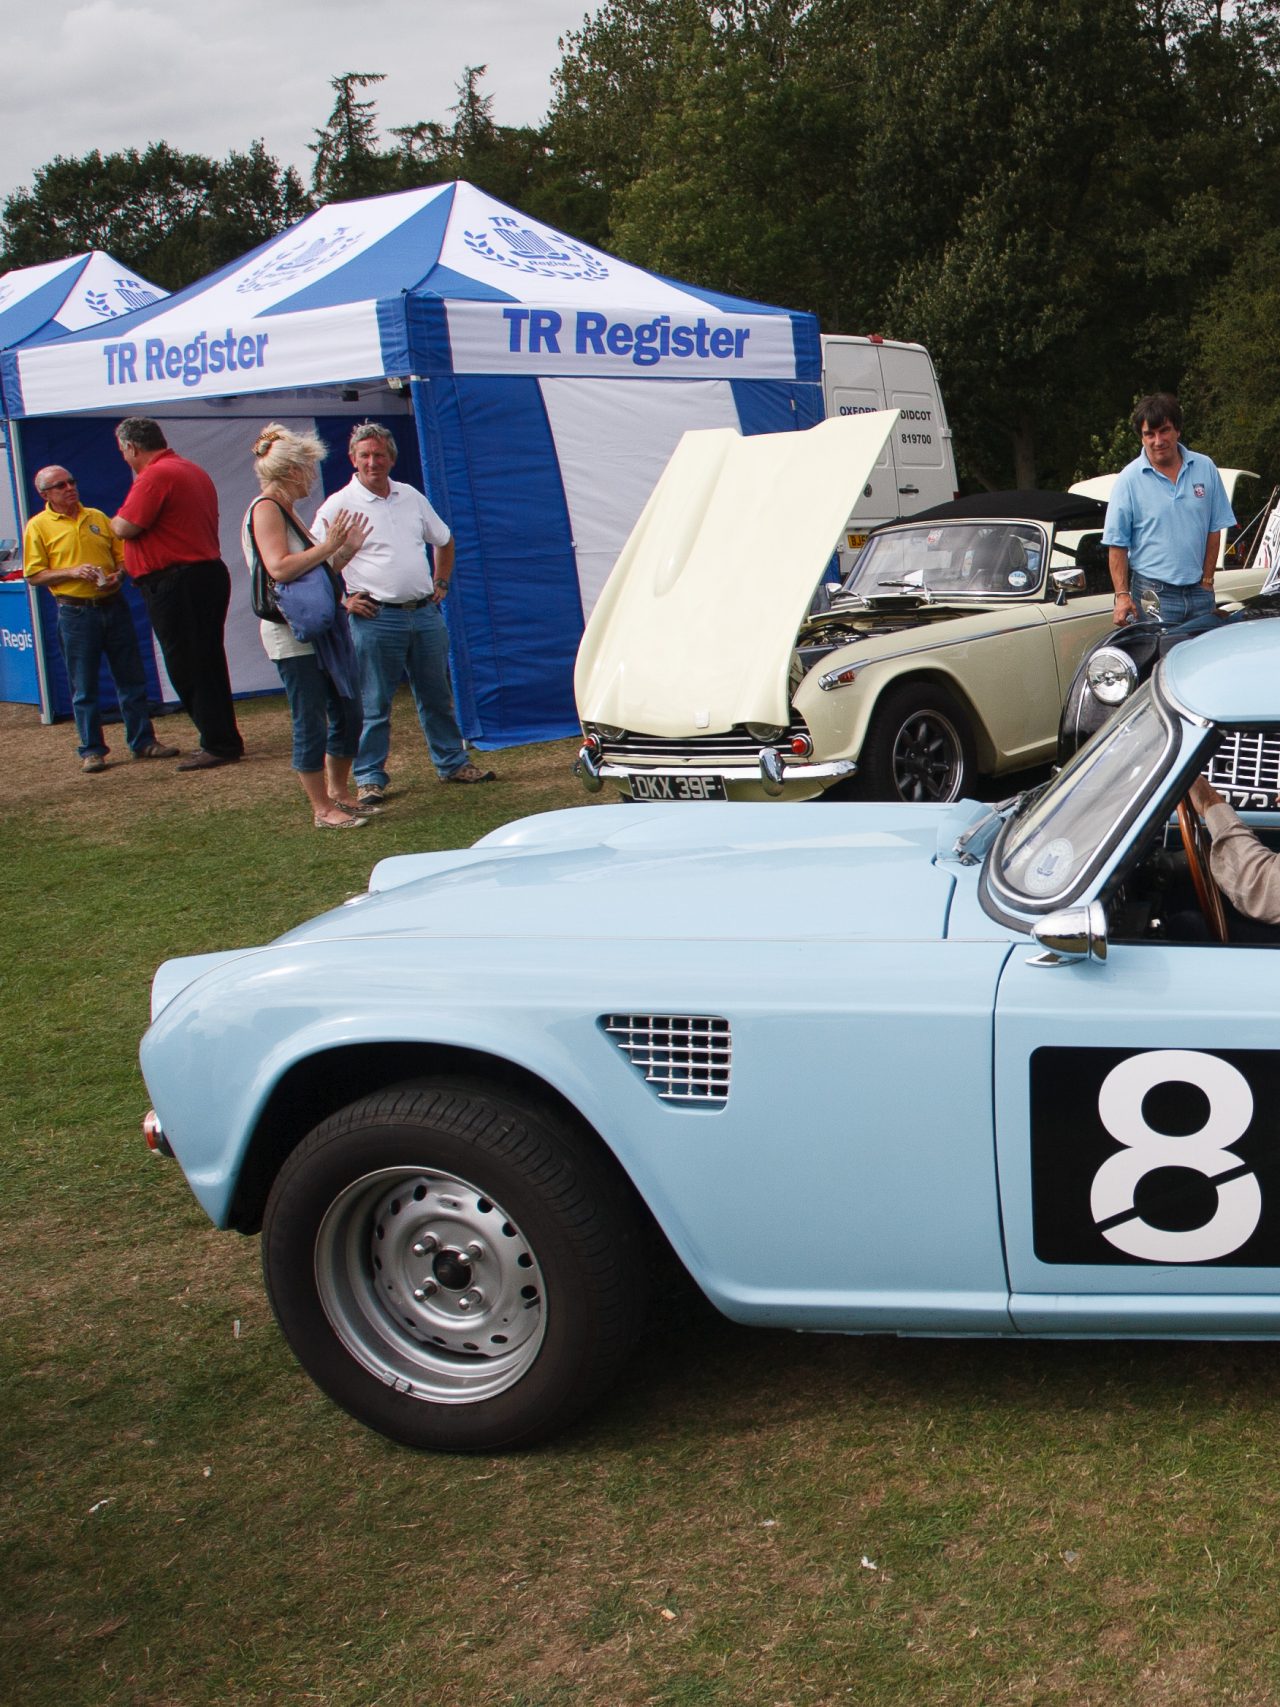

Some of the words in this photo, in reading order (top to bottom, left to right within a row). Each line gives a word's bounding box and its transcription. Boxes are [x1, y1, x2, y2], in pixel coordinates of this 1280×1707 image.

[488, 216, 520, 228] TR
[114, 279, 142, 289] TR
[503, 308, 562, 354] TR
[575, 311, 750, 367] Register
[103, 342, 138, 386] TR
[145, 328, 269, 387] Register
[900, 410, 931, 421] DIDCOT
[901, 434, 932, 445] 819700
[635, 776, 674, 799] DKX
[675, 777, 717, 799] 39F
